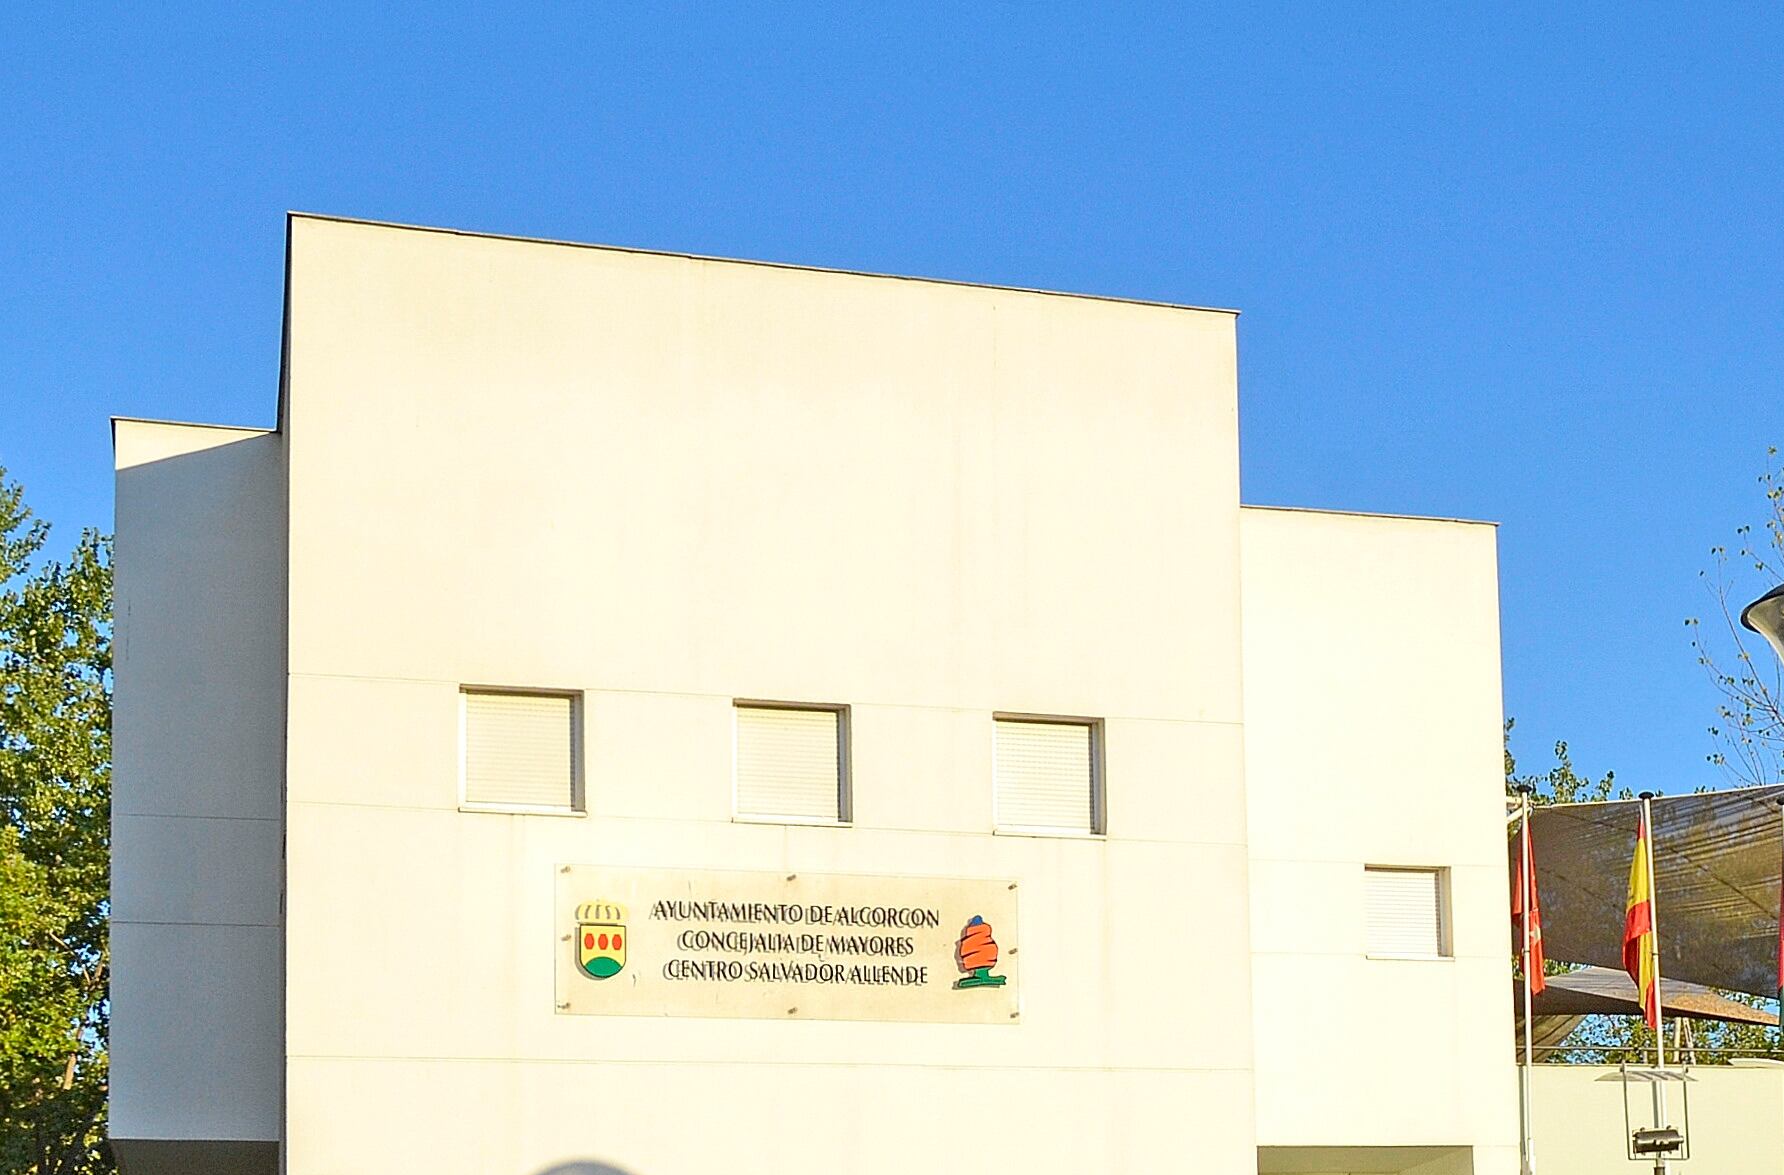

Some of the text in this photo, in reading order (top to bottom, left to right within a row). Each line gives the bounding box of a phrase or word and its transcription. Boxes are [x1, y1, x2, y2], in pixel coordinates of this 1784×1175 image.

[654, 899, 940, 926] AYUNTAMIENTO DE ALCORCON
[681, 929, 914, 954] CONCEJALIA DE MAYORES
[667, 959, 928, 984] CENTRO SALVADOR ALLENDE
